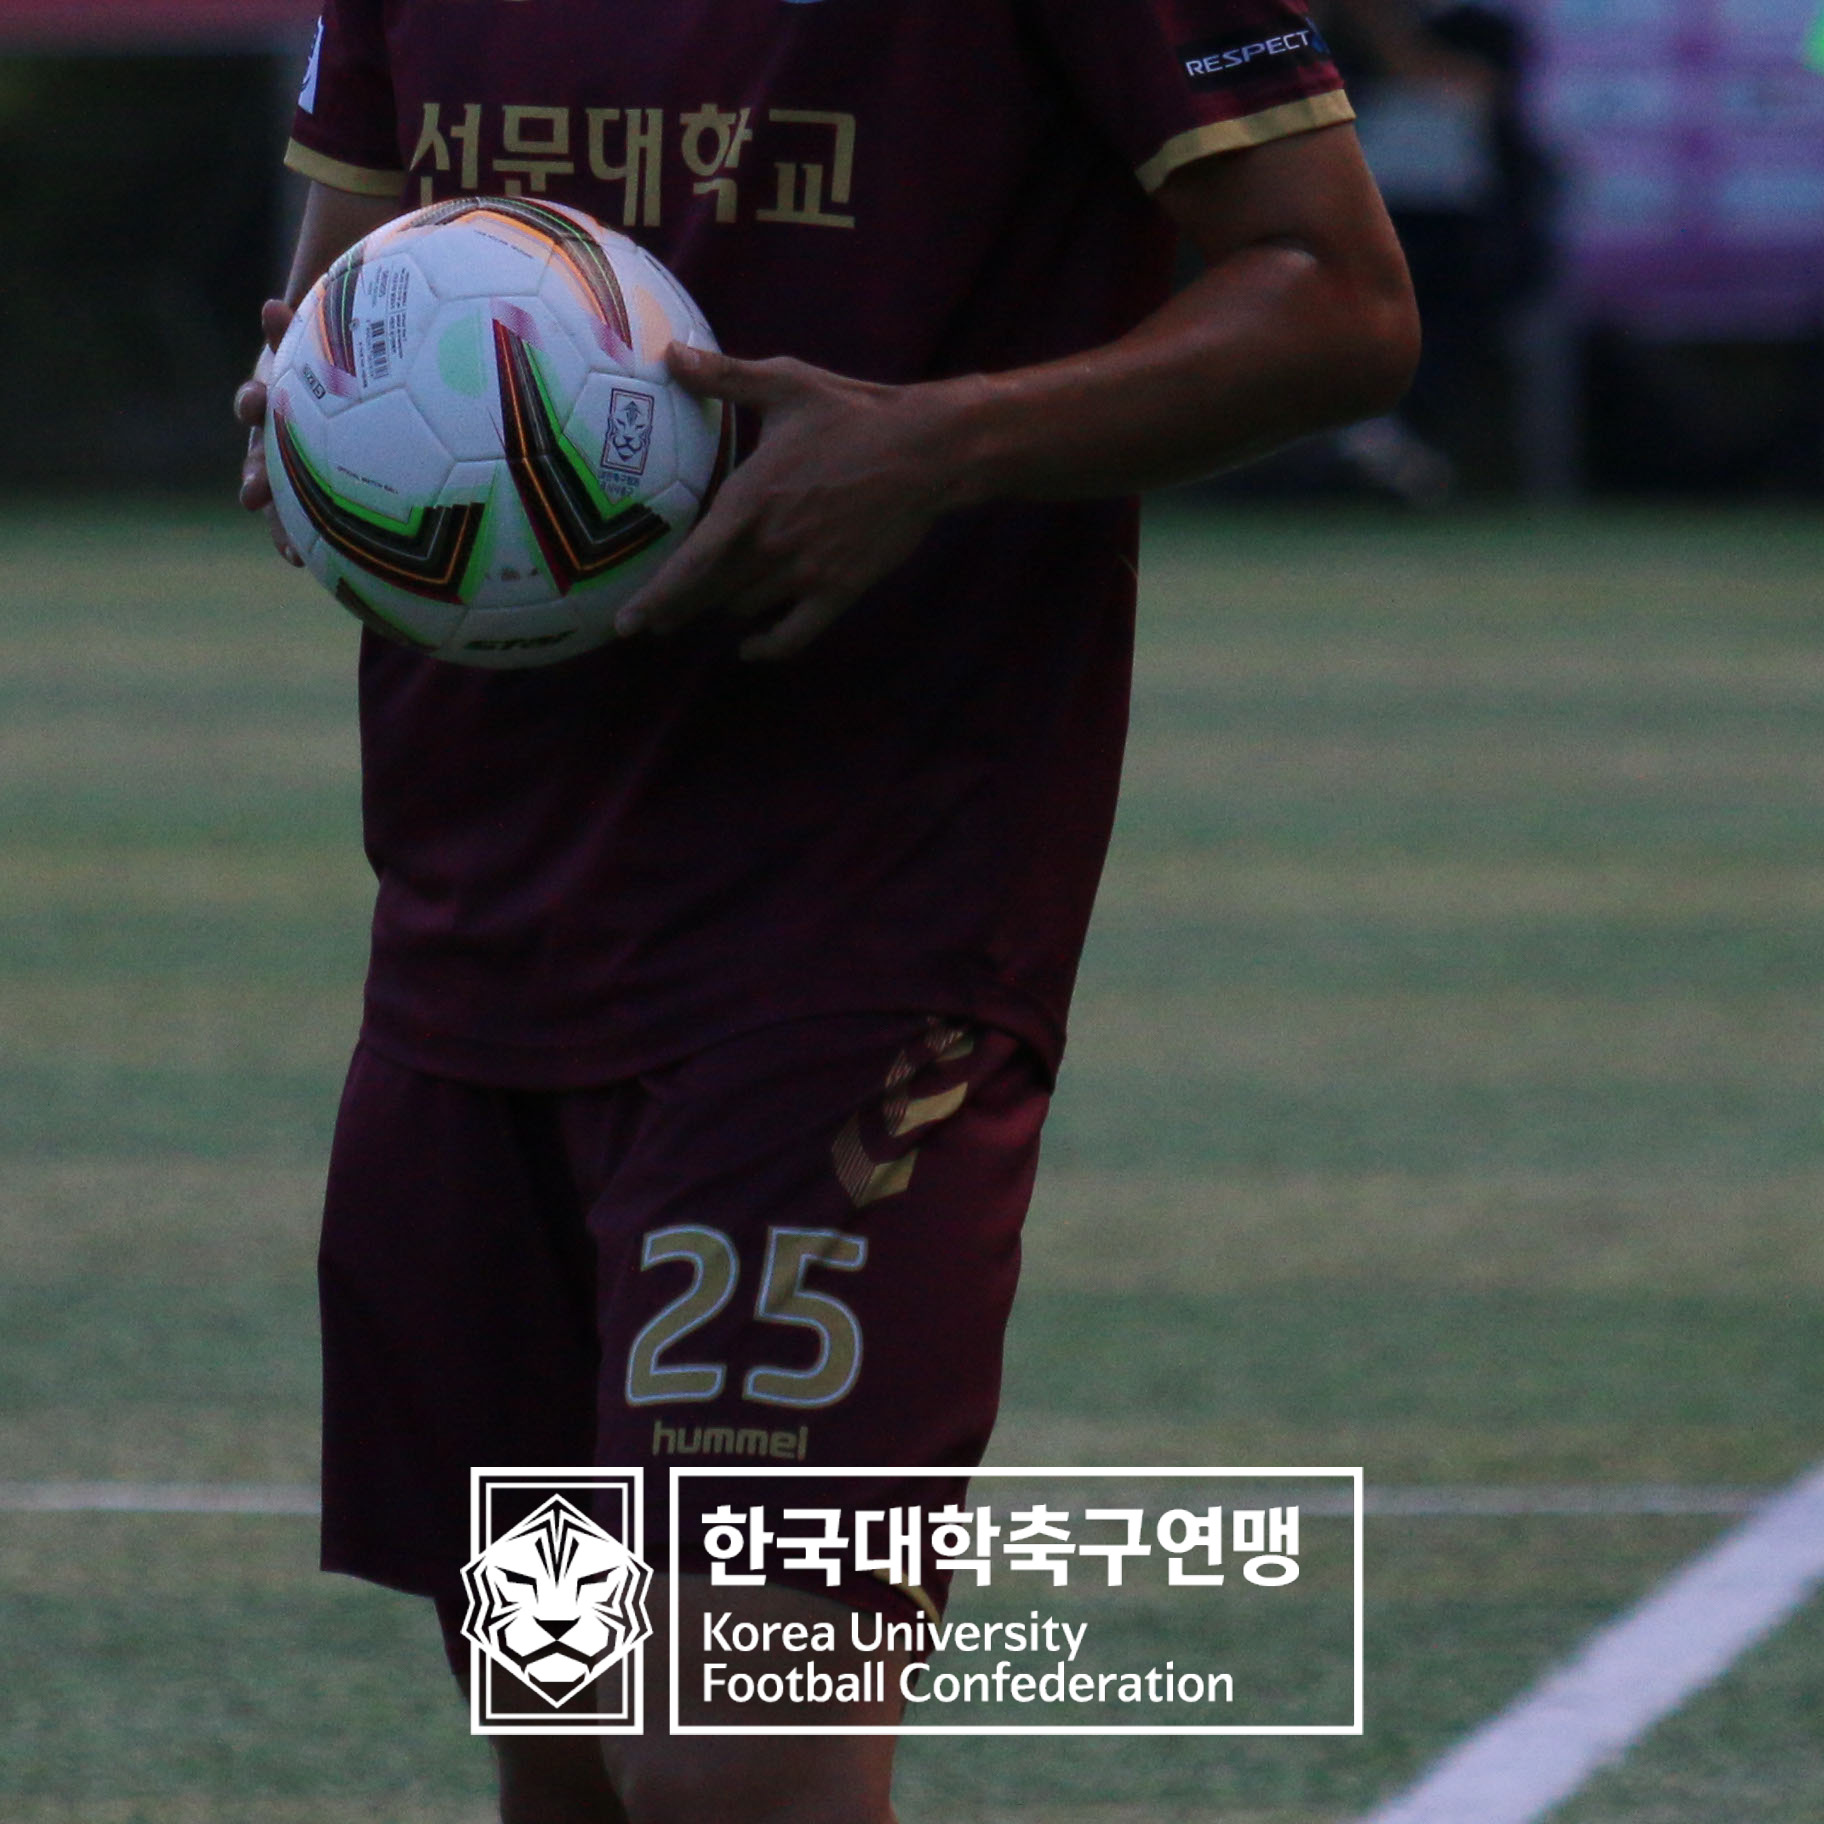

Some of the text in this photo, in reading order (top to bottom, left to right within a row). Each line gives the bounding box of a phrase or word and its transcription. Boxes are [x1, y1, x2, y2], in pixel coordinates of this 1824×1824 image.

[1184, 29, 1312, 78] RESPECT
[409, 102, 857, 229] 선문대학교
[624, 1223, 869, 1408] 25
[651, 1420, 809, 1460] hummel
